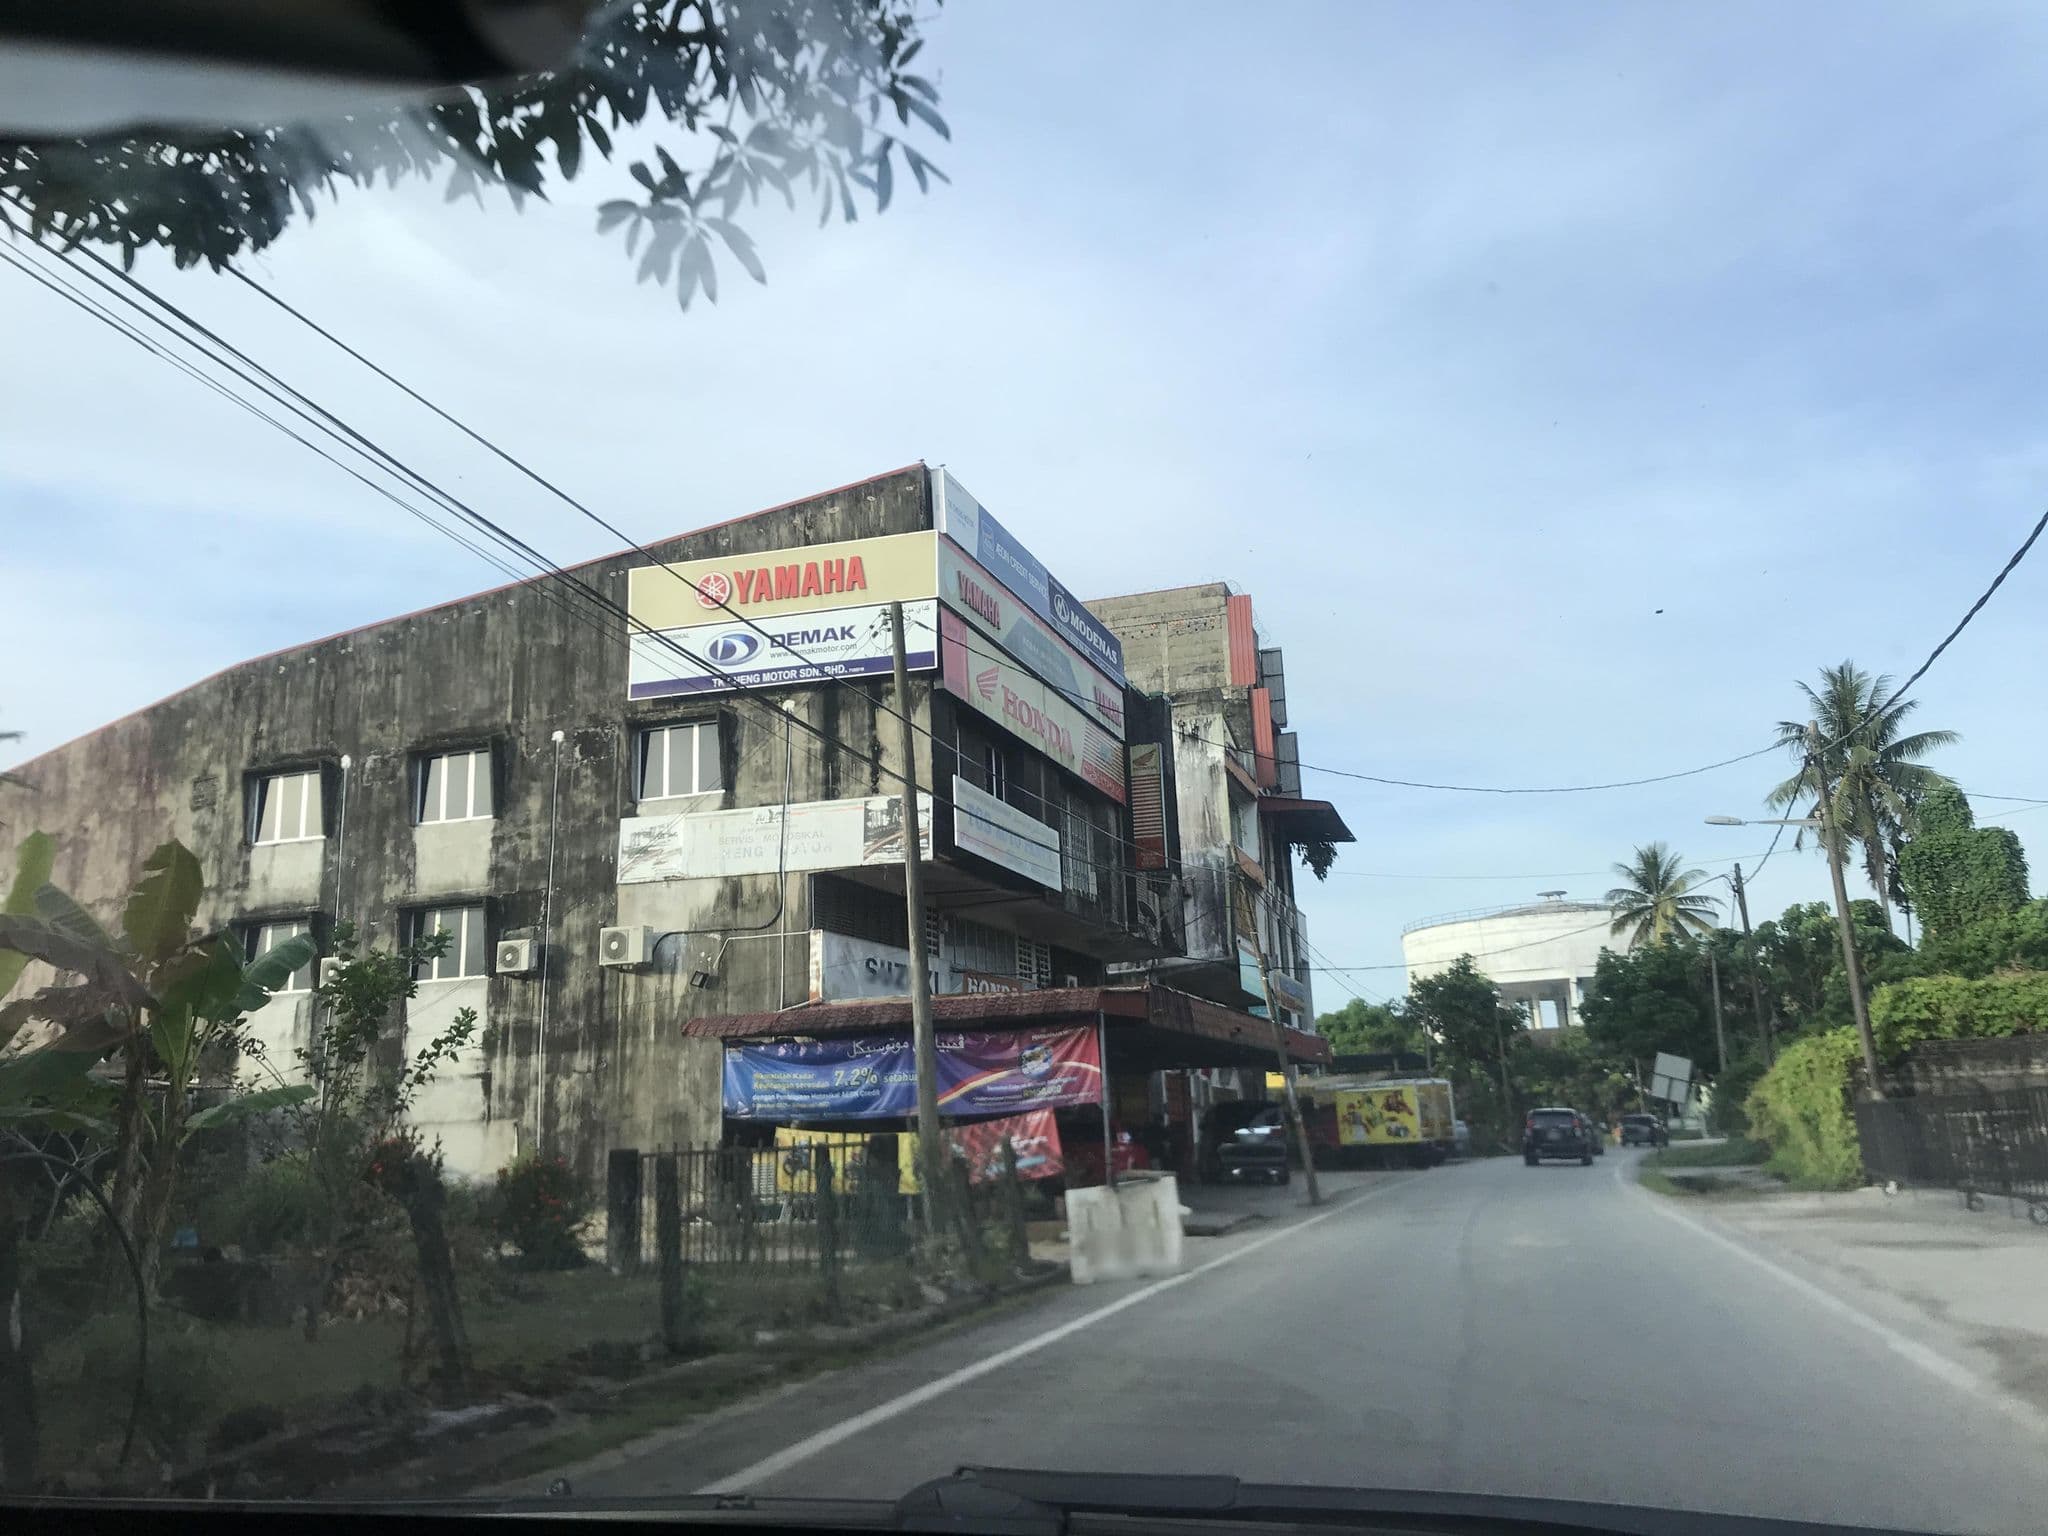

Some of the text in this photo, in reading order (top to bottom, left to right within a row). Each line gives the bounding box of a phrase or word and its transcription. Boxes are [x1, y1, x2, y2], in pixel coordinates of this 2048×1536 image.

[733, 556, 867, 605] YAMAHA
[957, 570, 1000, 630] YAMAHA
[770, 625, 857, 648] DEMAK
[1071, 610, 1118, 665] MODENAS
[762, 670, 797, 683] MOTOR
[799, 666, 822, 678] SDN.
[1002, 685, 1075, 761] HONDA
[834, 1066, 878, 1088] 7.2%
